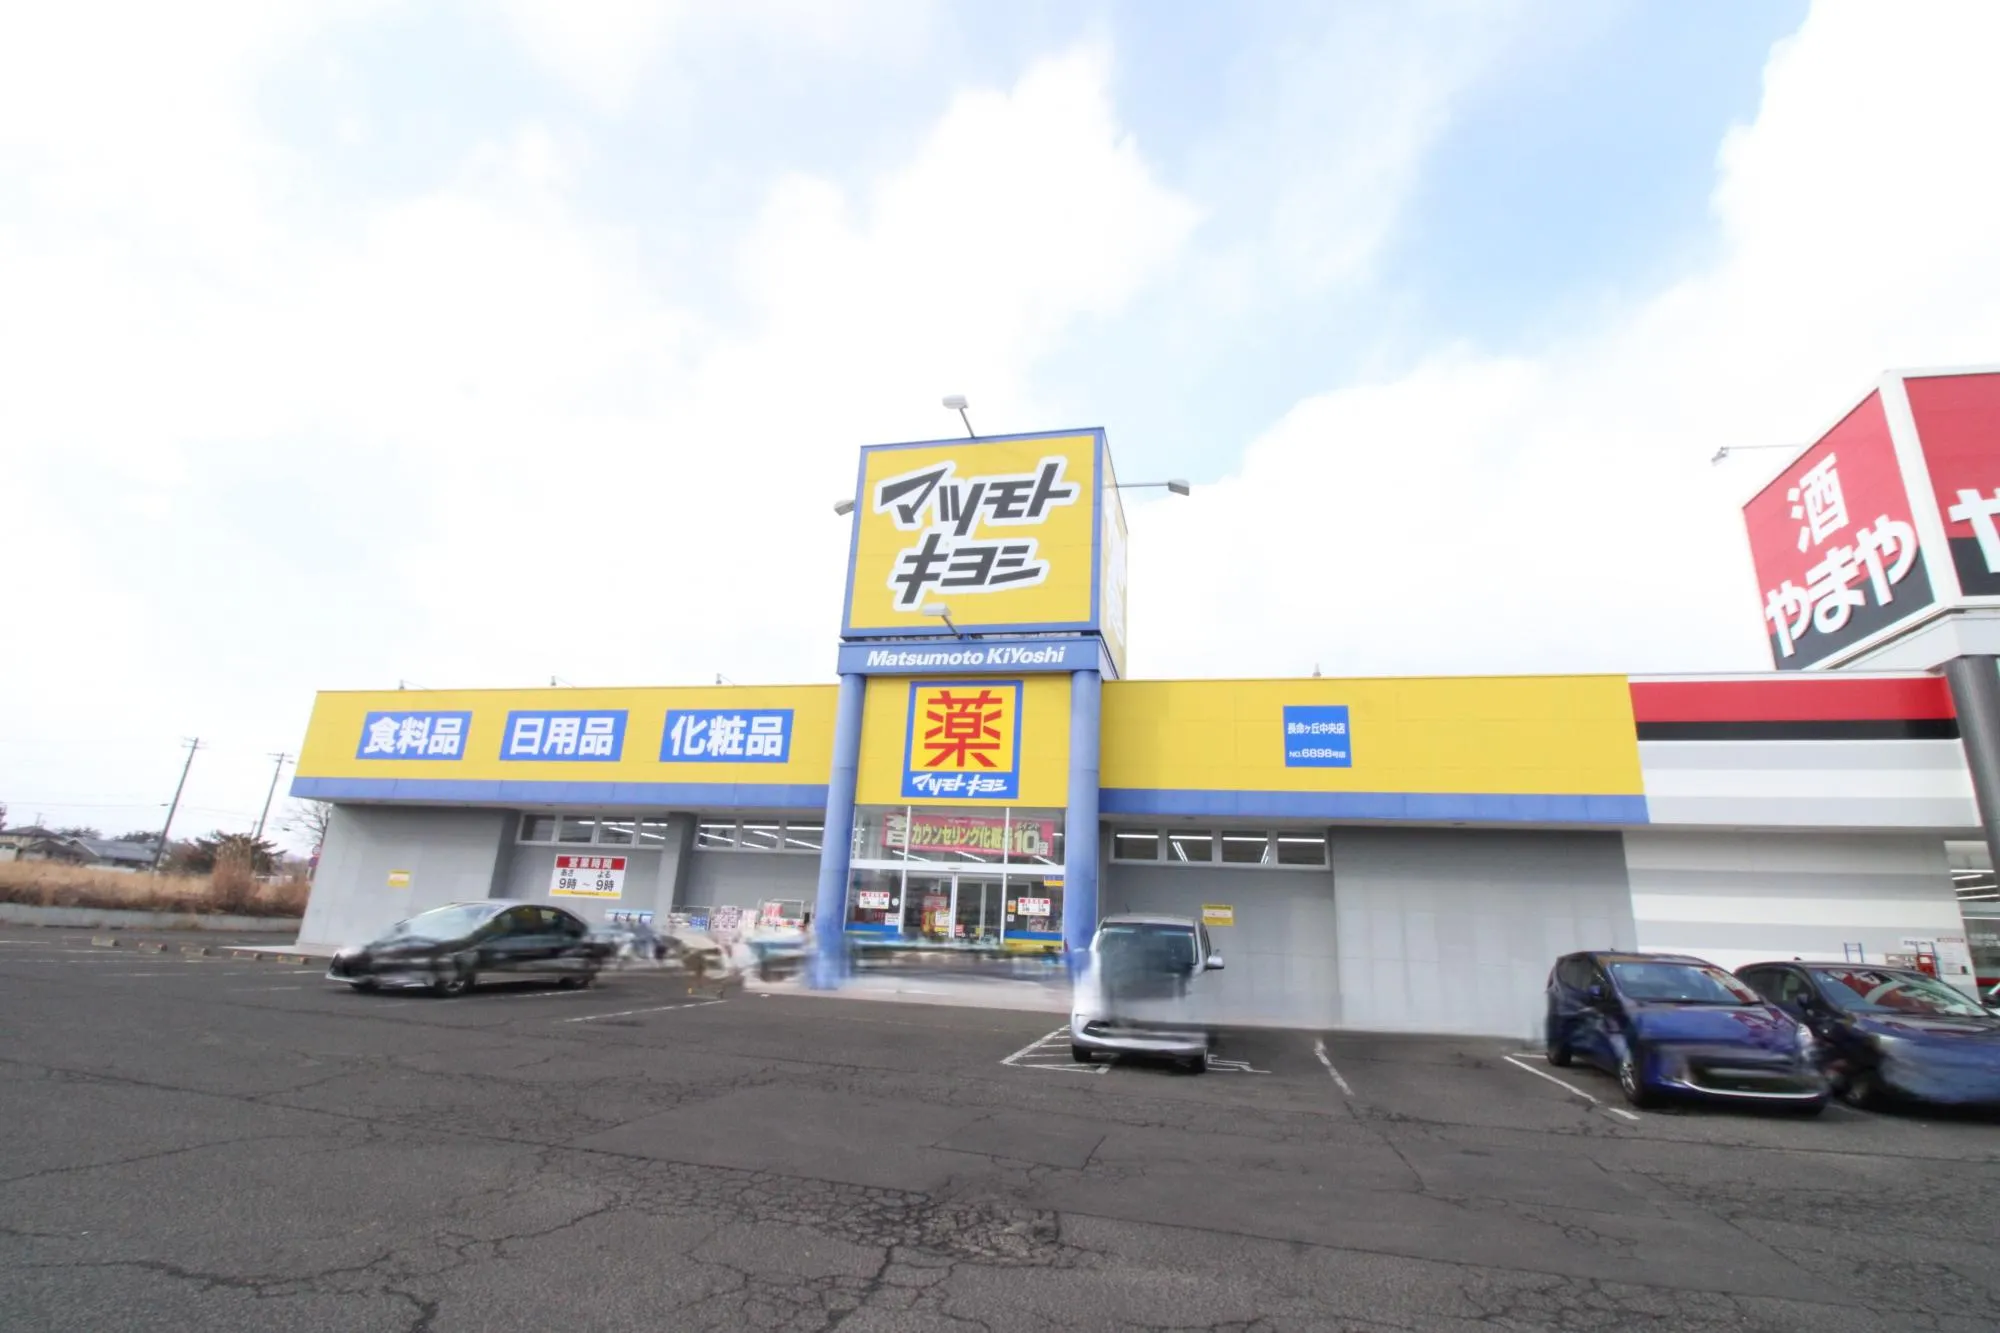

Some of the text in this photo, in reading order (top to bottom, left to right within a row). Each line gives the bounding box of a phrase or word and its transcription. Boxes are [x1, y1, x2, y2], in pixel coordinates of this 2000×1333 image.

[879, 461, 1073, 537] マツモト
[1787, 451, 1849, 553] 酒
[894, 532, 1042, 605] キヨシ
[1765, 513, 1917, 658] やまや
[866, 645, 1067, 667] Matsumoto KiYoshi
[363, 716, 463, 755] 食料品
[508, 717, 615, 756] 日用品
[670, 715, 783, 757] 化粧品
[923, 690, 1003, 768] 薬
[911, 772, 1009, 798] マツモトキヨシ
